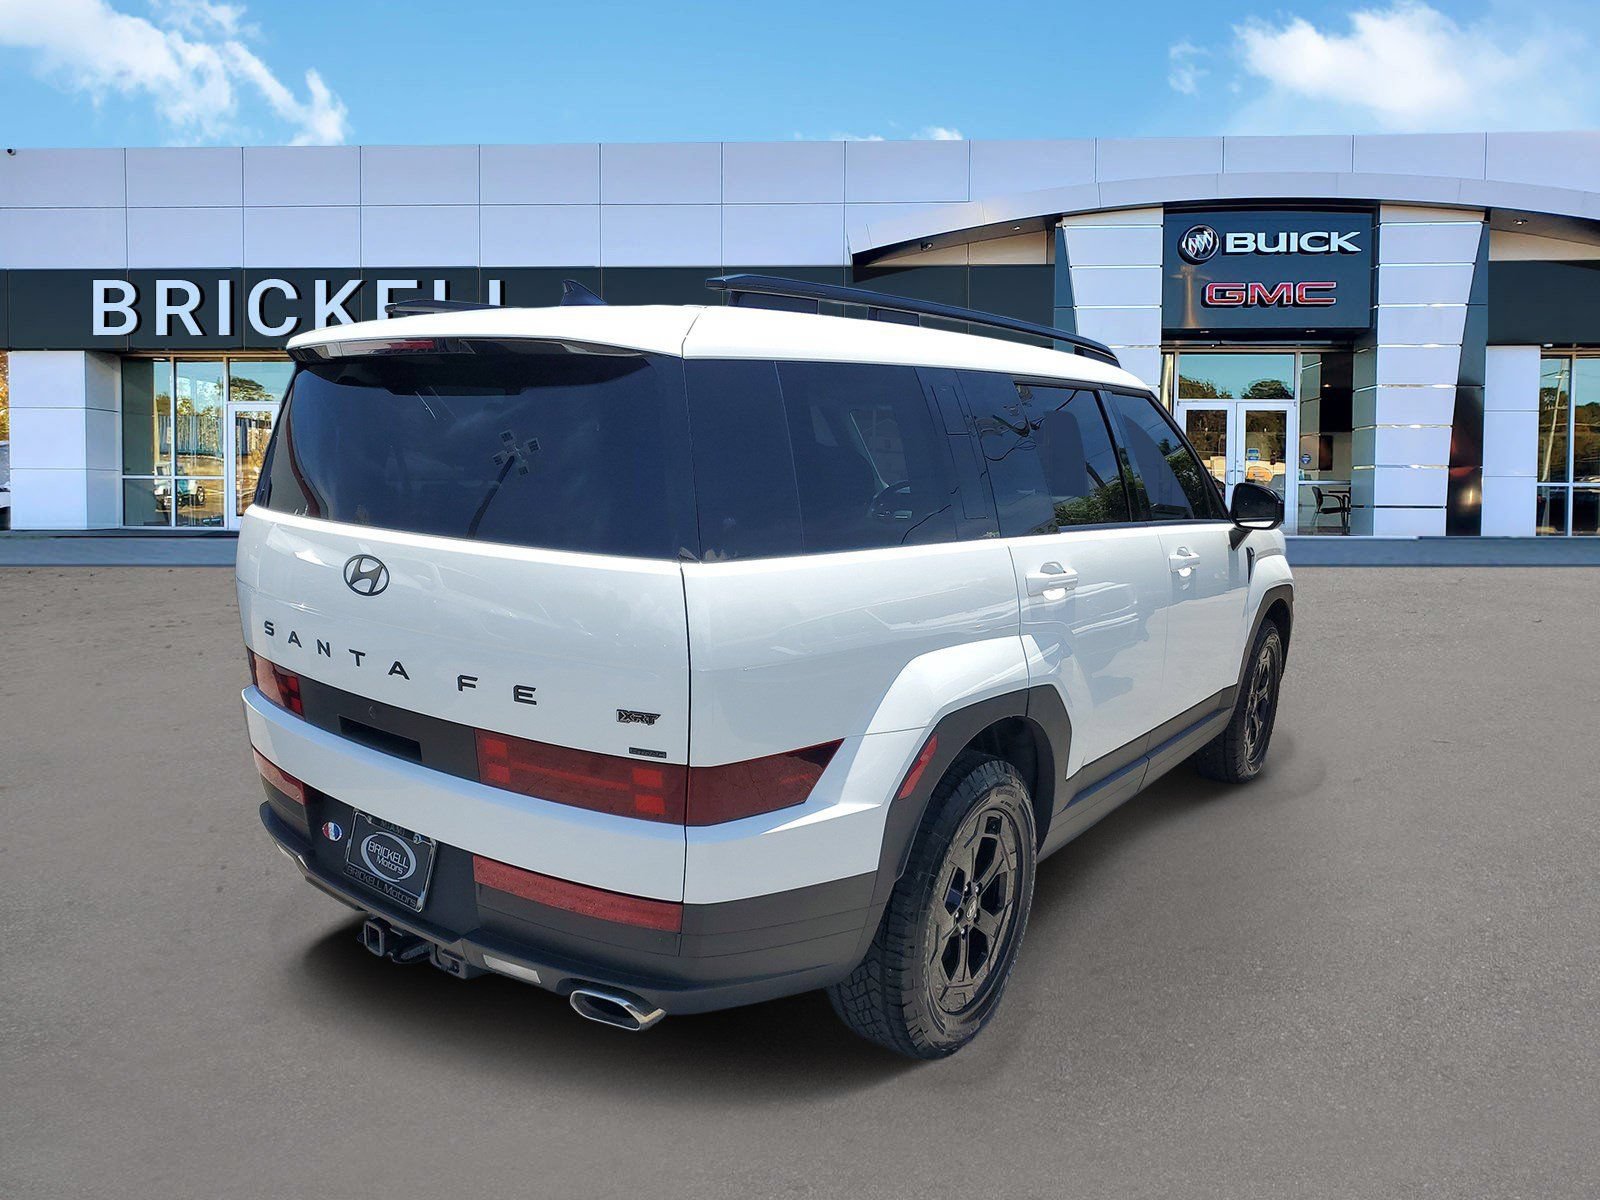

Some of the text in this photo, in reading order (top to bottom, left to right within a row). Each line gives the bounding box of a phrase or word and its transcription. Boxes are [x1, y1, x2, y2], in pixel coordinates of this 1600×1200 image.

[1225, 231, 1362, 254] BUICK
[1205, 281, 1337, 306] GMC
[263, 619, 538, 706] SANTA FE
[616, 709, 661, 726] XRT
[367, 840, 409, 869] BRICKELL
[376, 855, 404, 875] Motors
[346, 866, 417, 908] BRICKELL Motors
